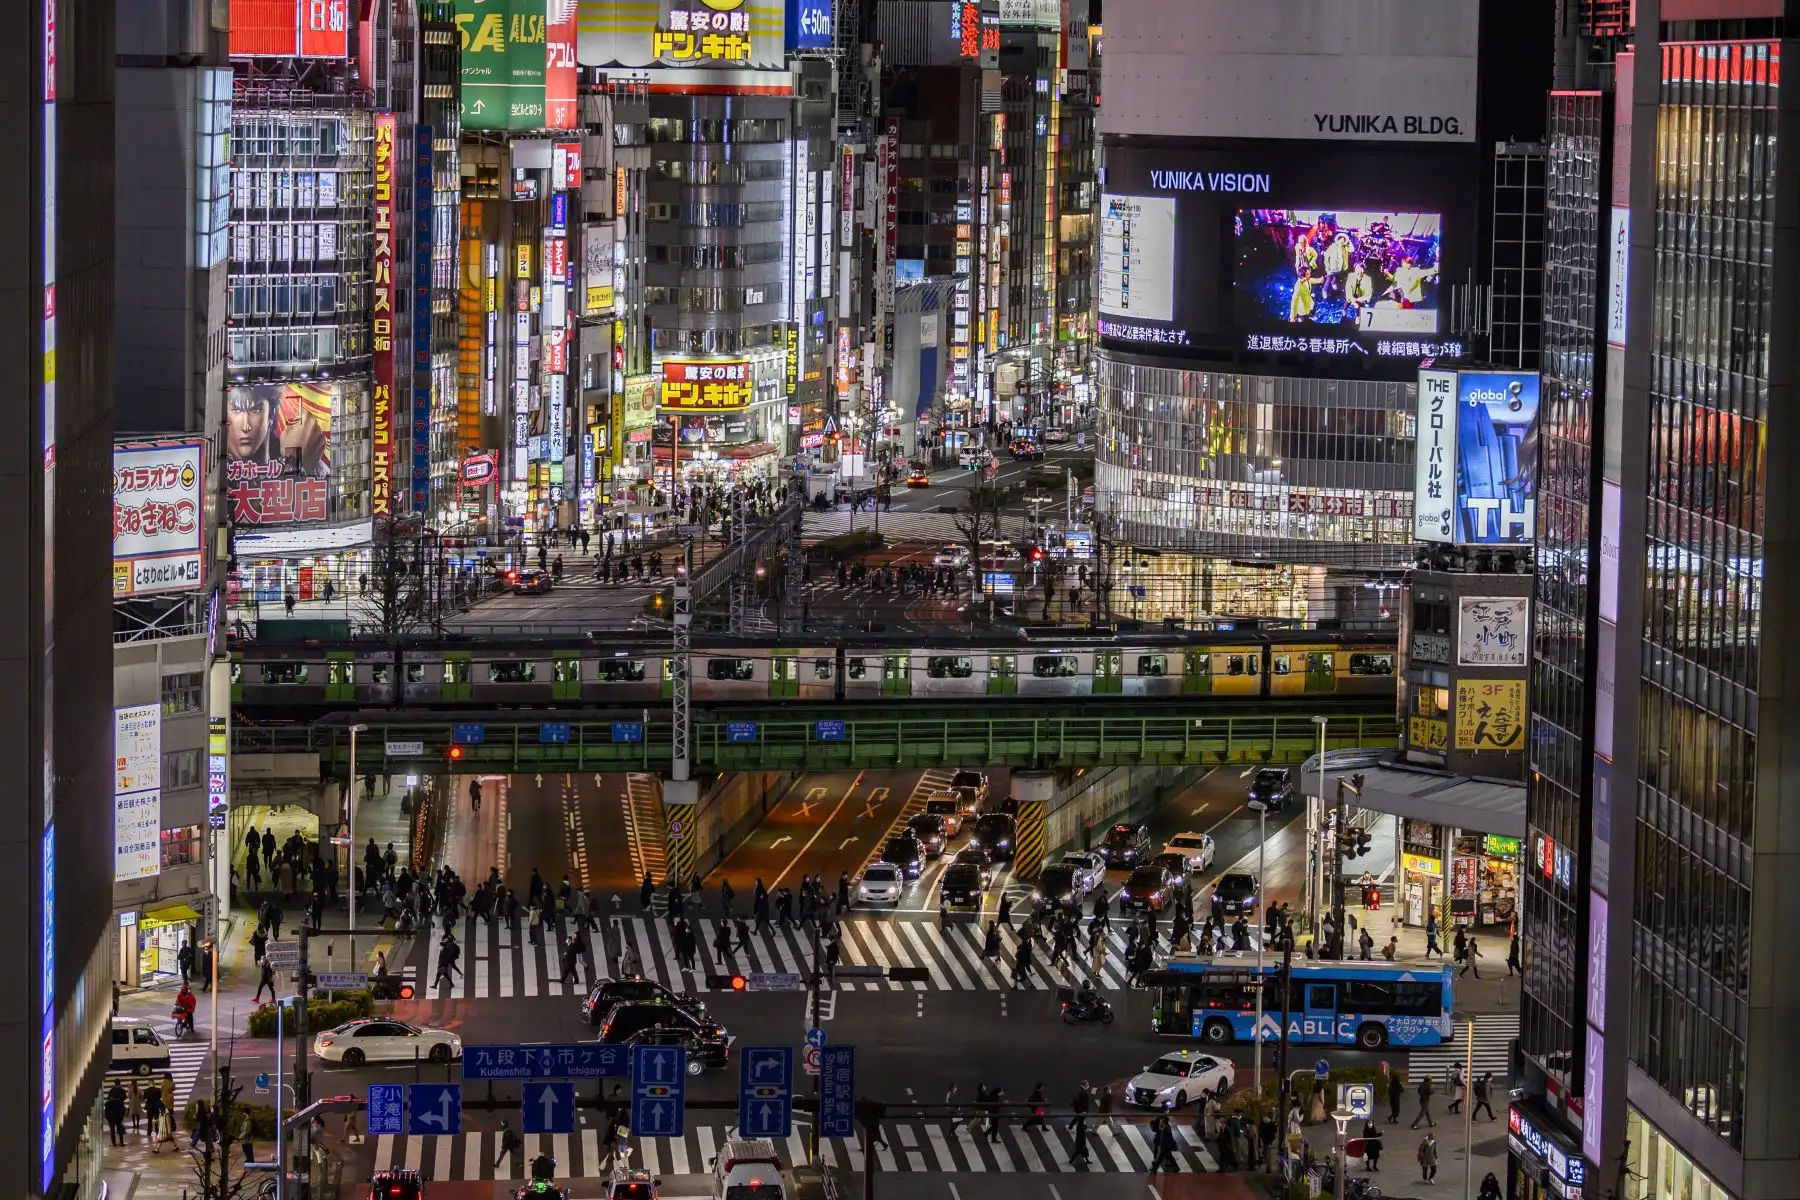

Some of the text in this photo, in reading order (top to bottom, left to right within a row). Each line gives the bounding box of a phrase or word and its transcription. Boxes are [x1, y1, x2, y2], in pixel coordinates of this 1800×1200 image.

[509, 14, 545, 43] ALSA
[811, 9, 829, 35] 50m
[546, 42, 575, 68] アコム
[555, 107, 566, 125] 3F
[1314, 113, 1463, 136] YUNIKA BLDG.
[376, 124, 392, 201] パチンコ
[1150, 169, 1271, 193] YUNIKA VISION
[887, 185, 896, 231] パセラ
[375, 206, 391, 313] エスパス
[555, 248, 563, 275] アイフル
[1366, 311, 1373, 328] 7
[1427, 378, 1450, 393] THE
[1469, 388, 1507, 407] global
[373, 384, 390, 444] パチンコ
[1428, 395, 1444, 499] グローバル社
[120, 466, 180, 493] カラオケ
[373, 452, 389, 514] エスパス
[231, 477, 328, 524] 大型店
[1290, 494, 1363, 516] 大処分市
[1418, 512, 1440, 527] global
[136, 564, 199, 585] となりのビル 4F
[1481, 684, 1504, 698] 3F
[1467, 687, 1475, 727] ハイボール
[1458, 730, 1474, 739] 200
[1286, 1020, 1352, 1038] ABLIC
[476, 1049, 536, 1066] 九段下
[480, 1066, 606, 1077] Kudanshita Ichigaya
[835, 1051, 851, 1132] 新宿駅東口
[383, 1087, 401, 1131] 小滝橋
